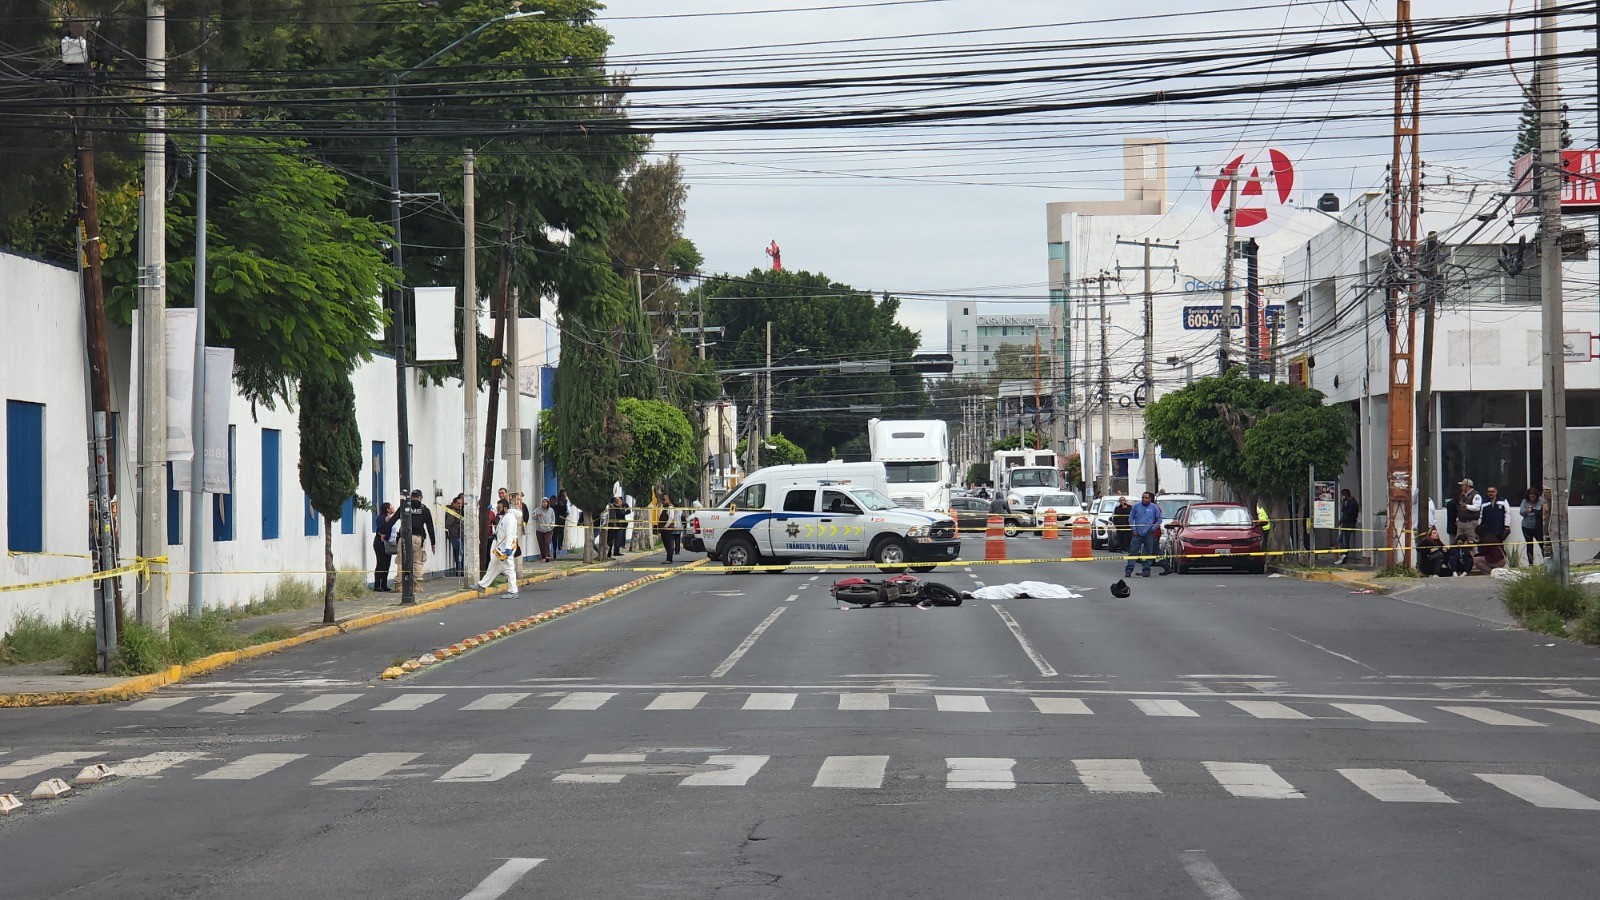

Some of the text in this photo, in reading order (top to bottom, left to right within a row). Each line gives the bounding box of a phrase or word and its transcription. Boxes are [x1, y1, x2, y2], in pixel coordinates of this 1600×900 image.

[976, 315, 1046, 325] CASA INN HOTEL
[786, 541, 811, 550] TRÁNSITO
[816, 542, 837, 551] POLICÍA
[837, 543, 850, 551] VIAL
